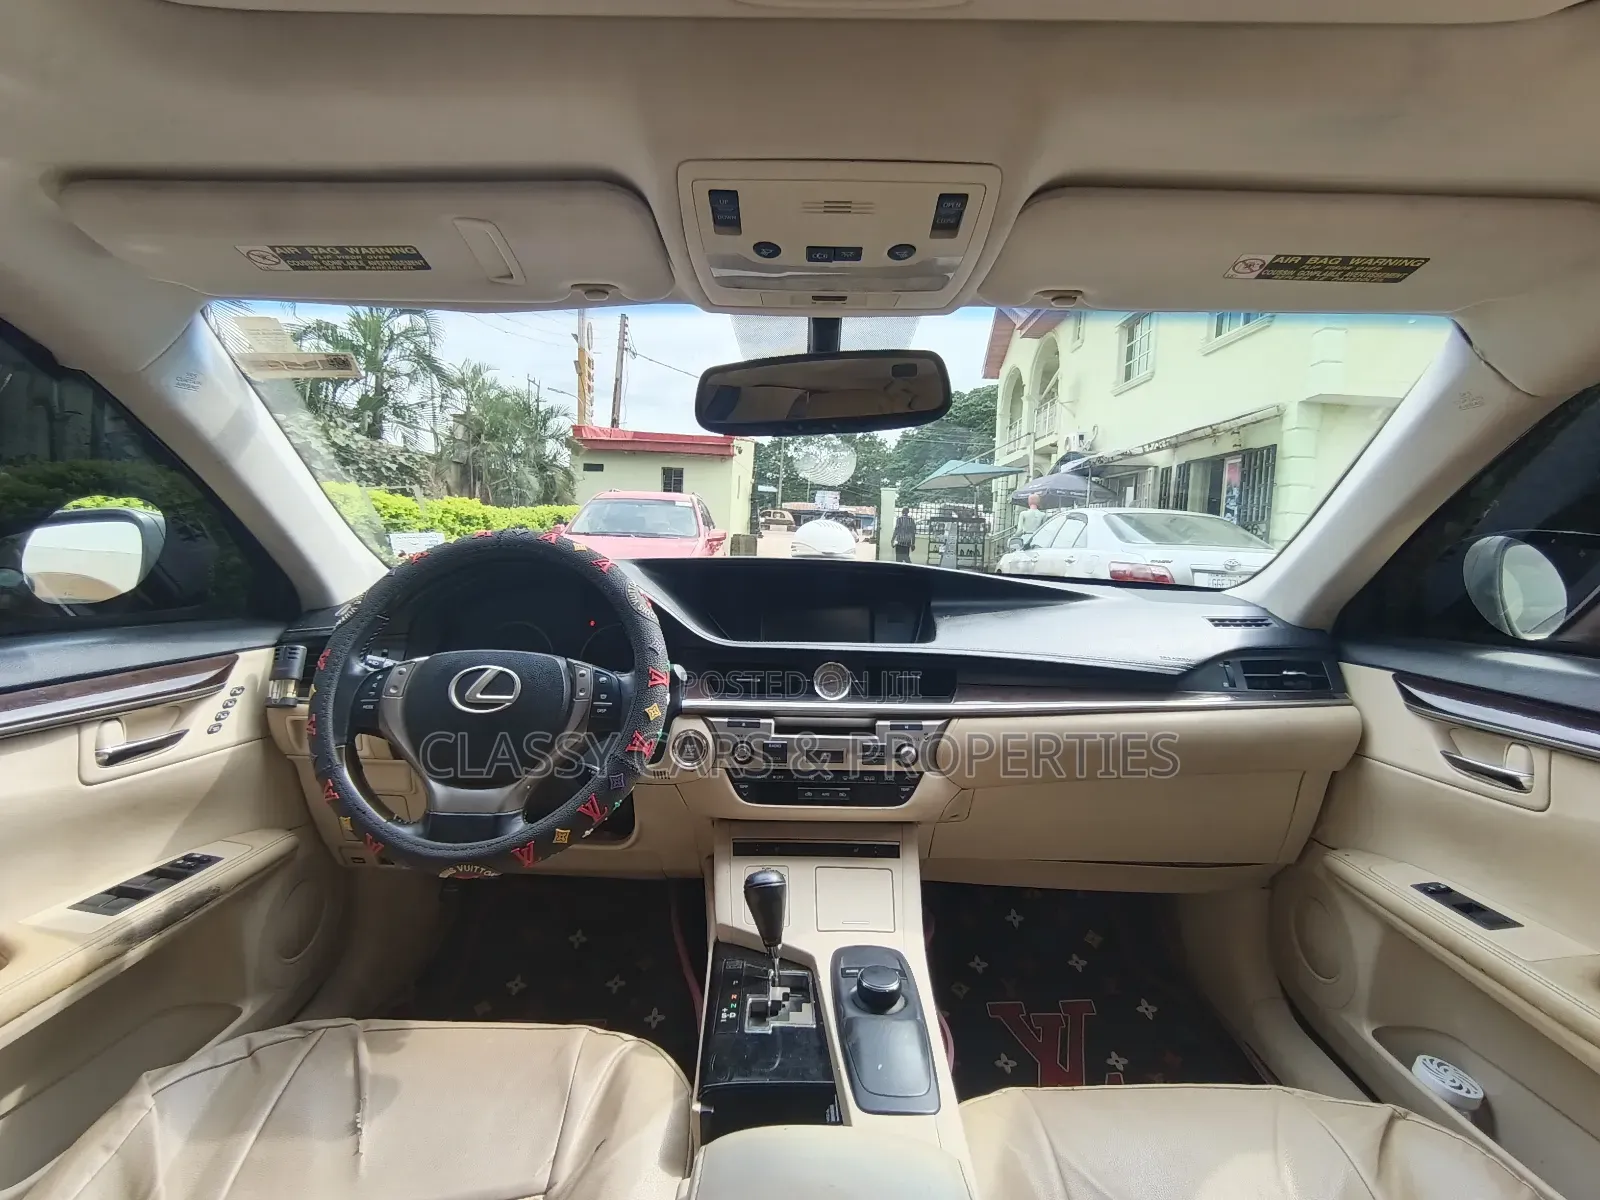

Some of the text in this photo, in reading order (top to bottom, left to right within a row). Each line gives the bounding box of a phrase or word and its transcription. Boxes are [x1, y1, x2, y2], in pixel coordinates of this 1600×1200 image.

[275, 246, 417, 255] AIR BAG WARNING
[1272, 256, 1425, 267] AIR BAG WARNING
